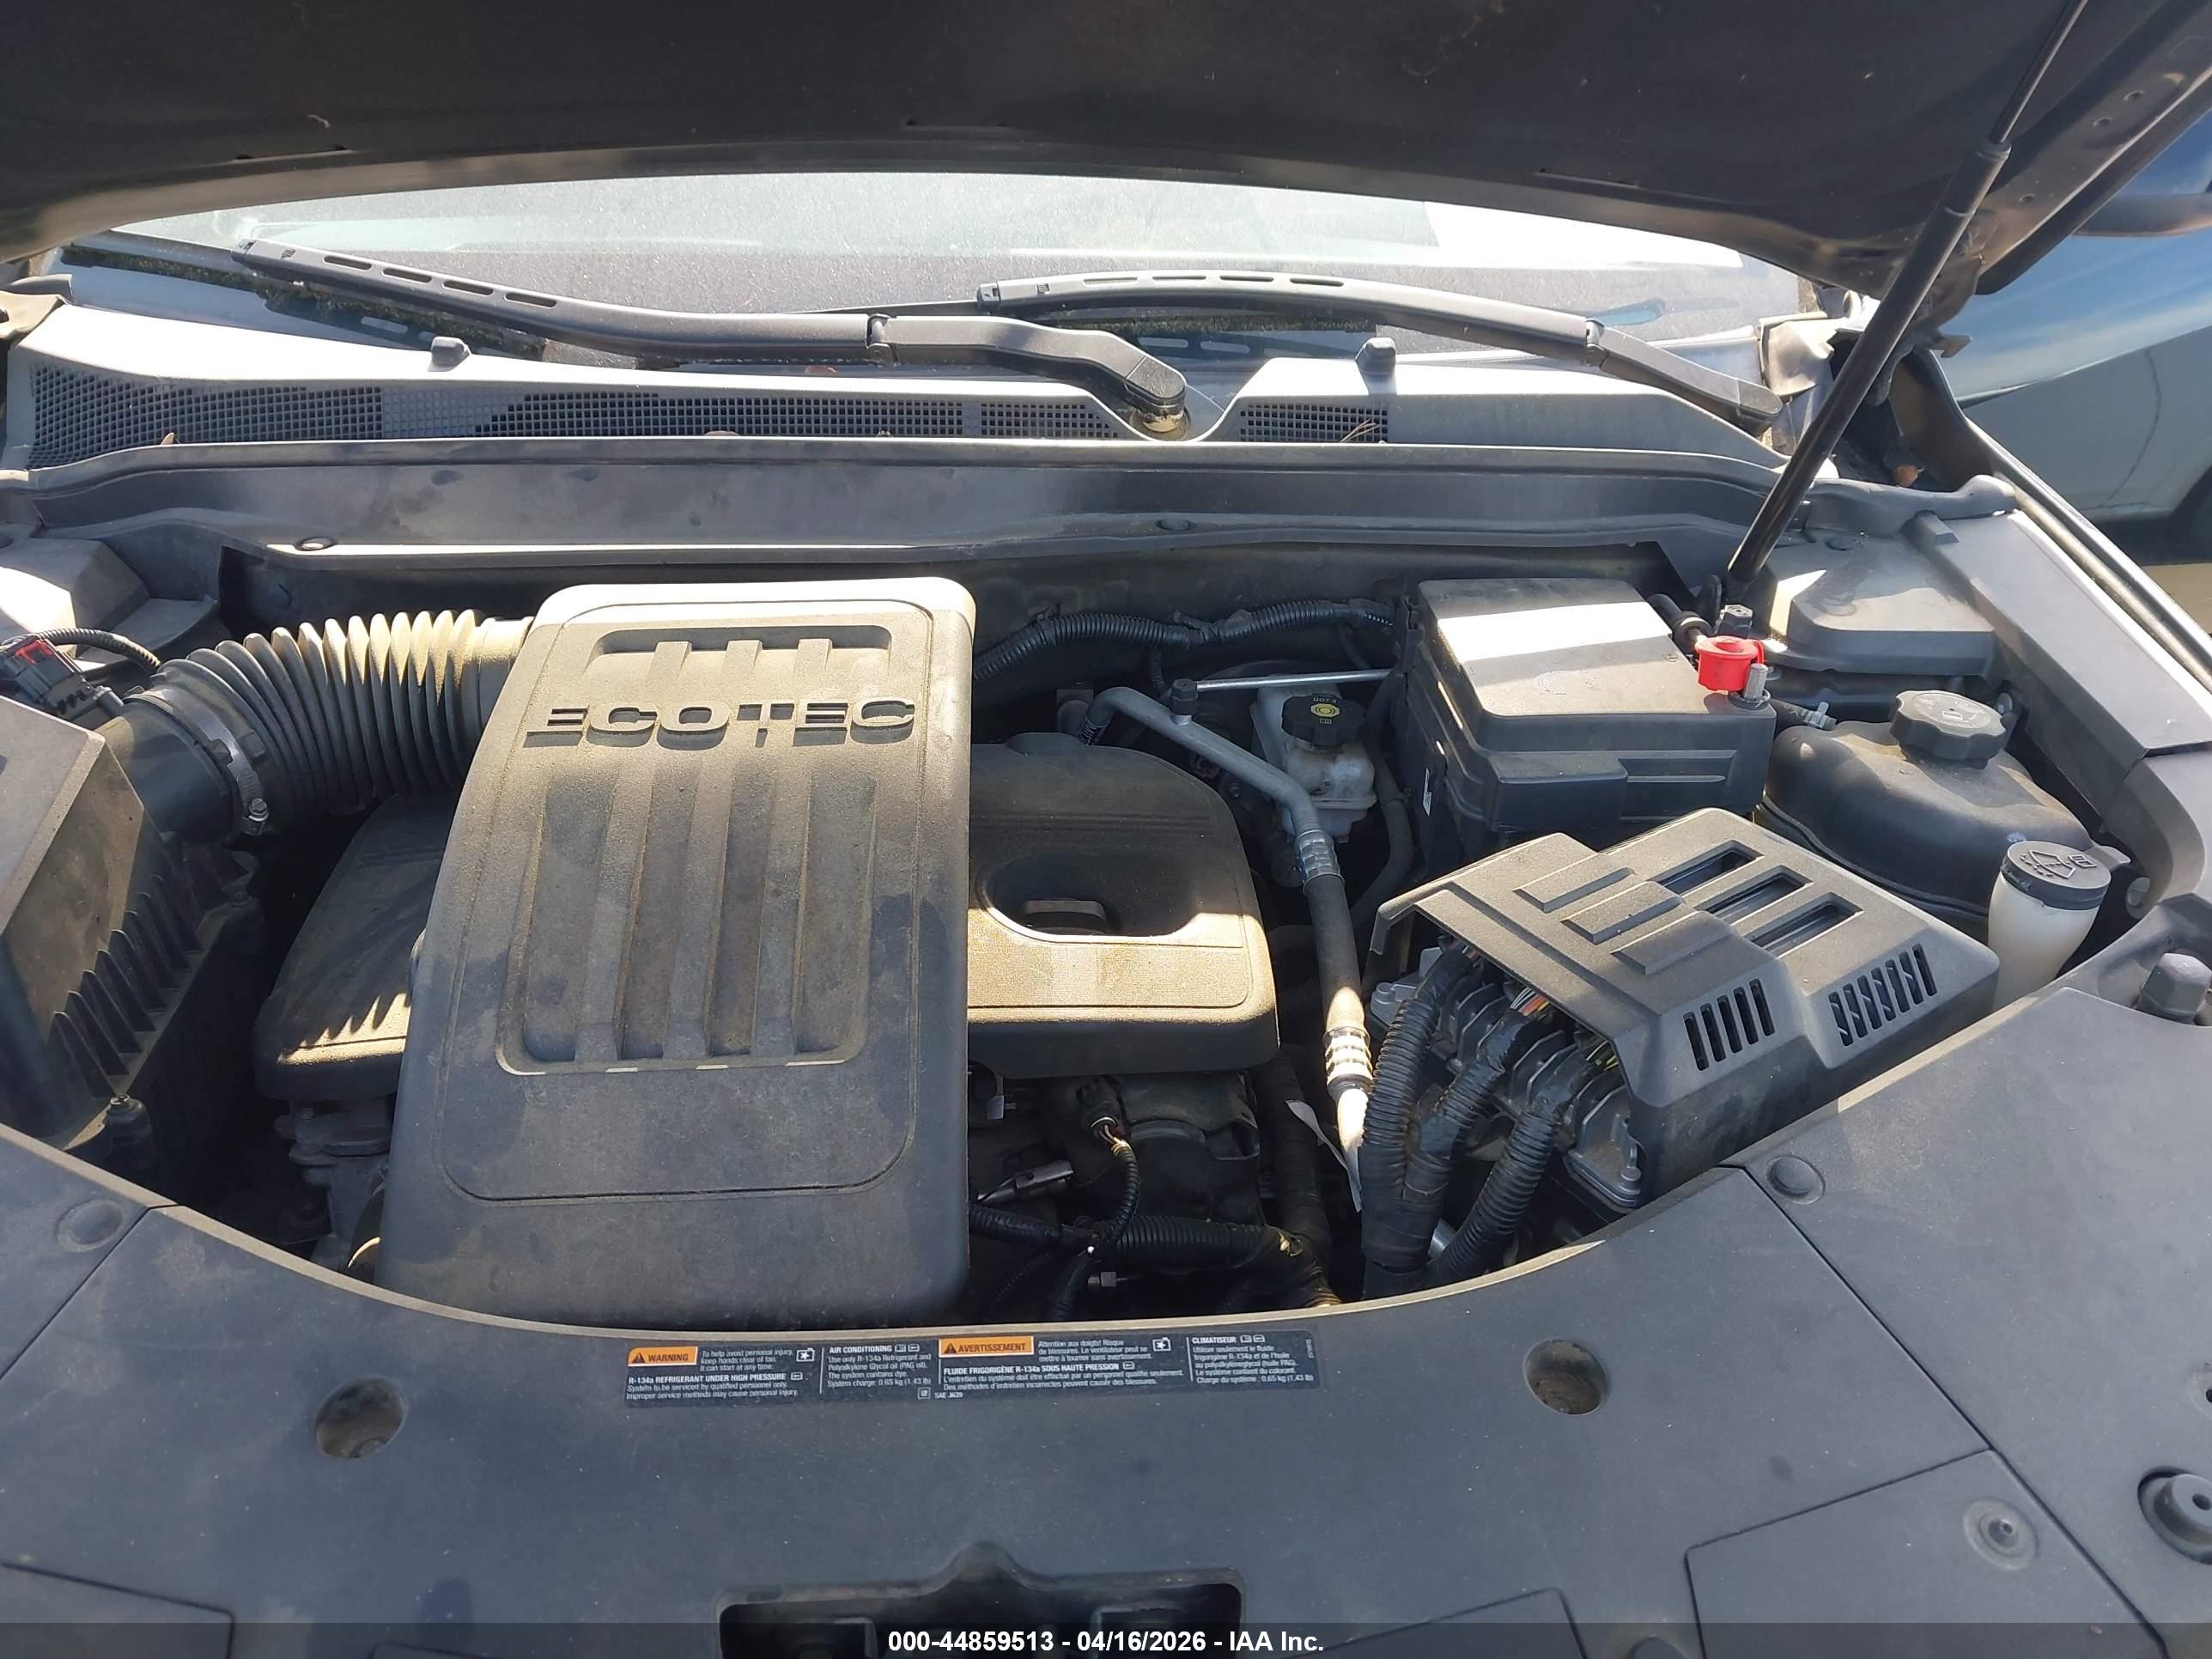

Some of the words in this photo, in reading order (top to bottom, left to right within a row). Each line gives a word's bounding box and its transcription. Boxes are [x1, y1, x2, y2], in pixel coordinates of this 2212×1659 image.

[522, 696, 916, 750] ECOTEC
[958, 1343, 1026, 1352] AVERTISSEMENT
[1079, 1340, 1101, 1348] doigts!
[744, 1349, 773, 1358] personal
[1124, 1346, 1139, 1354] peut
[647, 1353, 689, 1362] WARNING
[882, 1354, 918, 1363] Refrigerant
[899, 1361, 915, 1370] (PAG
[969, 1364, 1014, 1375] FRIGORIGÈNE
[1085, 1363, 1119, 1371] PRESSION
[655, 1375, 704, 1383] REFRIGERANT
[705, 1374, 729, 1382] UNDER
[894, 1378, 903, 1387] kg
[903, 1377, 921, 1386] (1.43
[922, 1376, 932, 1385] lb)
[988, 1374, 1014, 1383] système
[627, 1384, 652, 1393] System
[709, 1382, 738, 1390] qualified
[739, 1381, 772, 1390] personnel
[773, 1381, 787, 1389] only.
[1026, 1380, 1061, 1389] incorrectes
[1062, 1380, 1088, 1389] peuvent
[626, 1392, 656, 1401] Improper
[749, 1389, 777, 1398] personal
[779, 1389, 798, 1397] injury.
